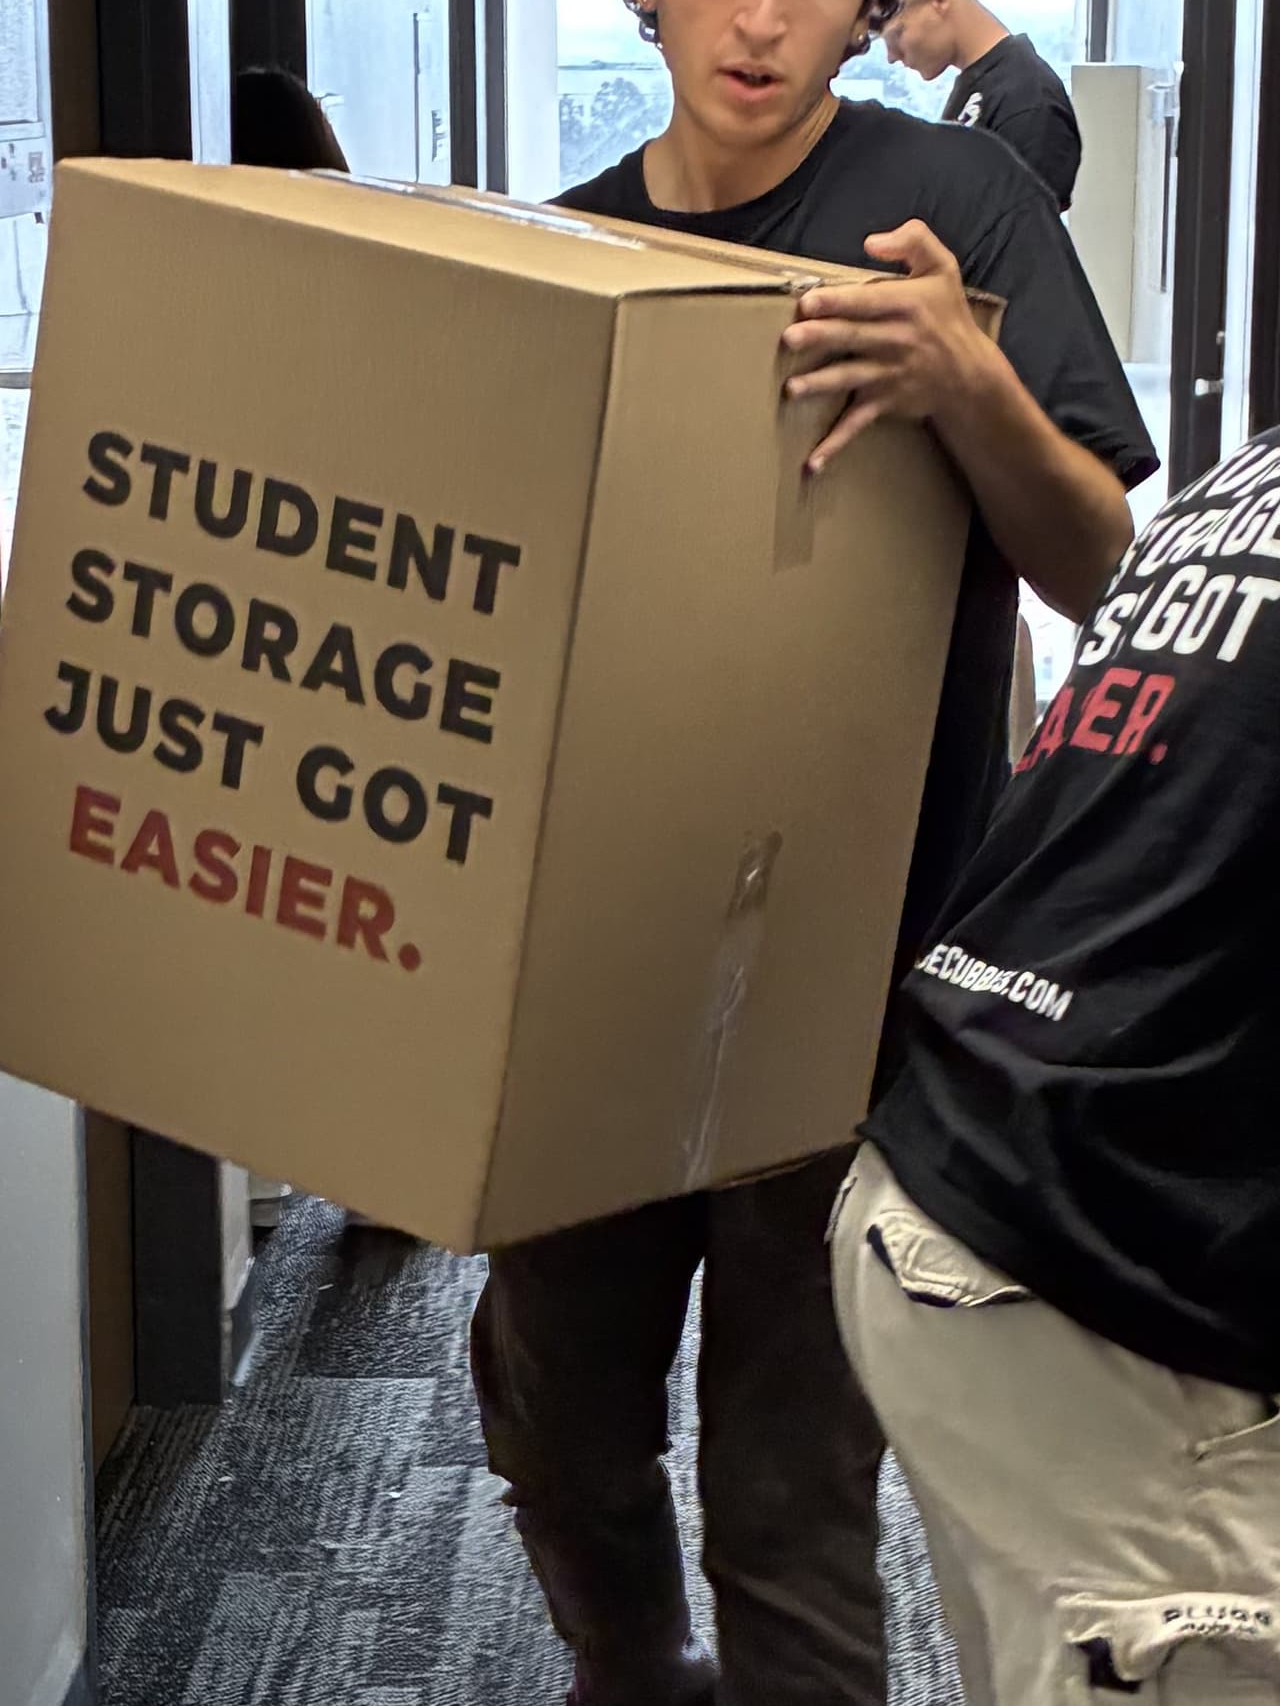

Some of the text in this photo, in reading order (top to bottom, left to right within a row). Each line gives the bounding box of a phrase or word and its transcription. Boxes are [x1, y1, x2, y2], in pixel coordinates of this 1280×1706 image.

[82, 431, 521, 616] STUDENT
[66, 549, 502, 745] STORAGE
[44, 660, 494, 866] JUST GOT
[69, 785, 422, 972] EASIER.
